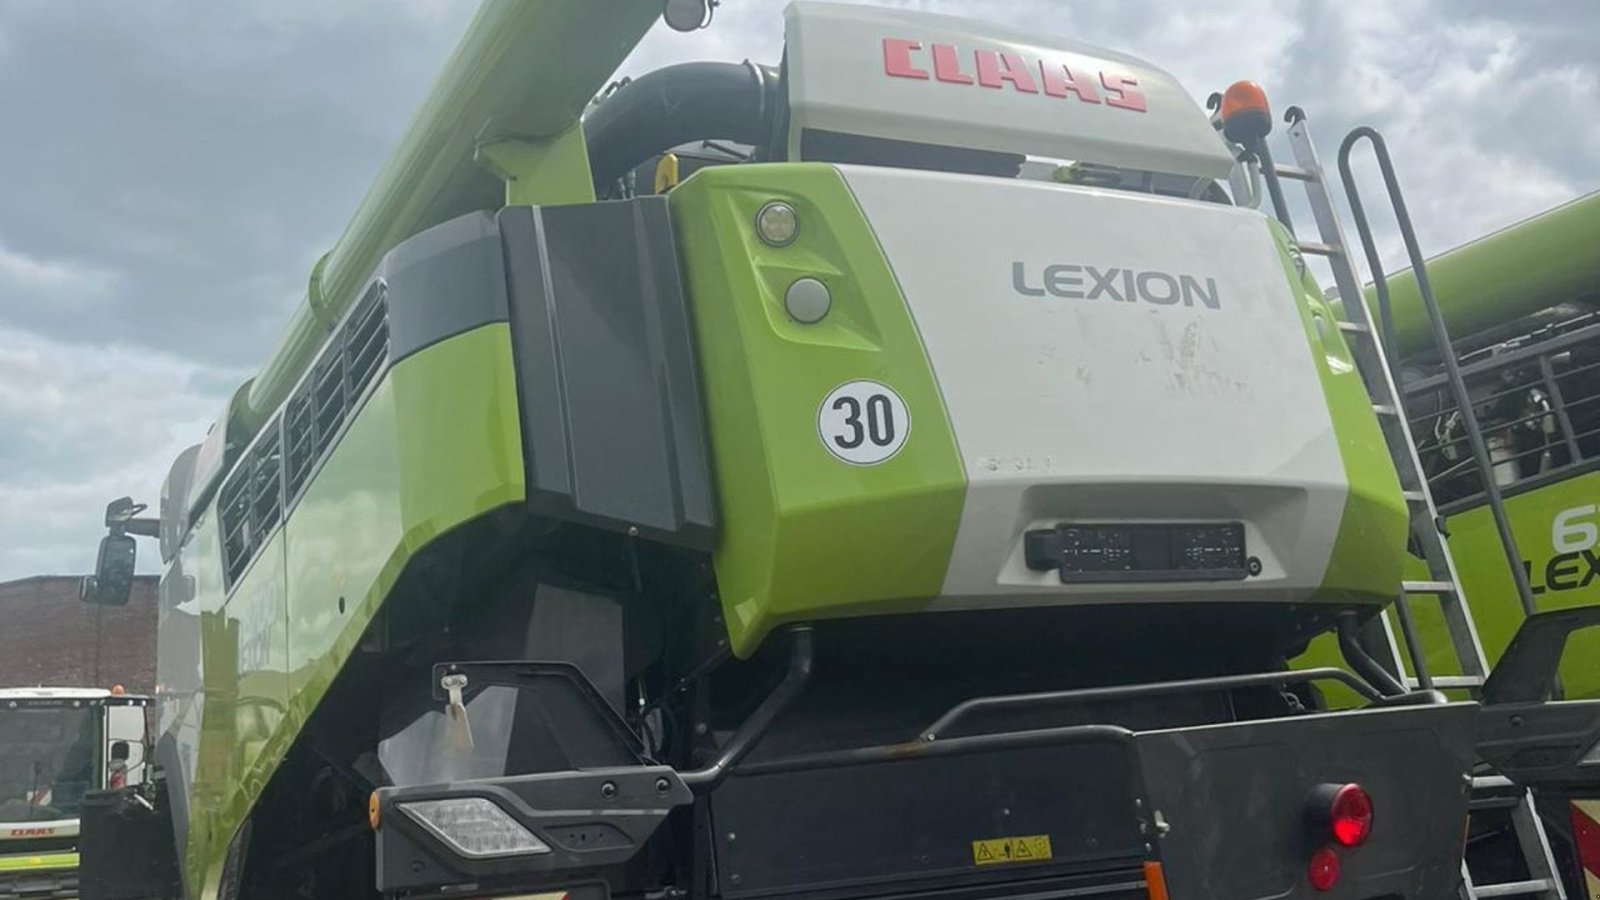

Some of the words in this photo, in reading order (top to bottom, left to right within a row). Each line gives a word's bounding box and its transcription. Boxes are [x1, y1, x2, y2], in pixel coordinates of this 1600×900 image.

[882, 38, 1148, 113] CLAAS
[1012, 261, 1221, 309] LEXION
[832, 394, 896, 449] 30
[1553, 505, 1600, 553] 6
